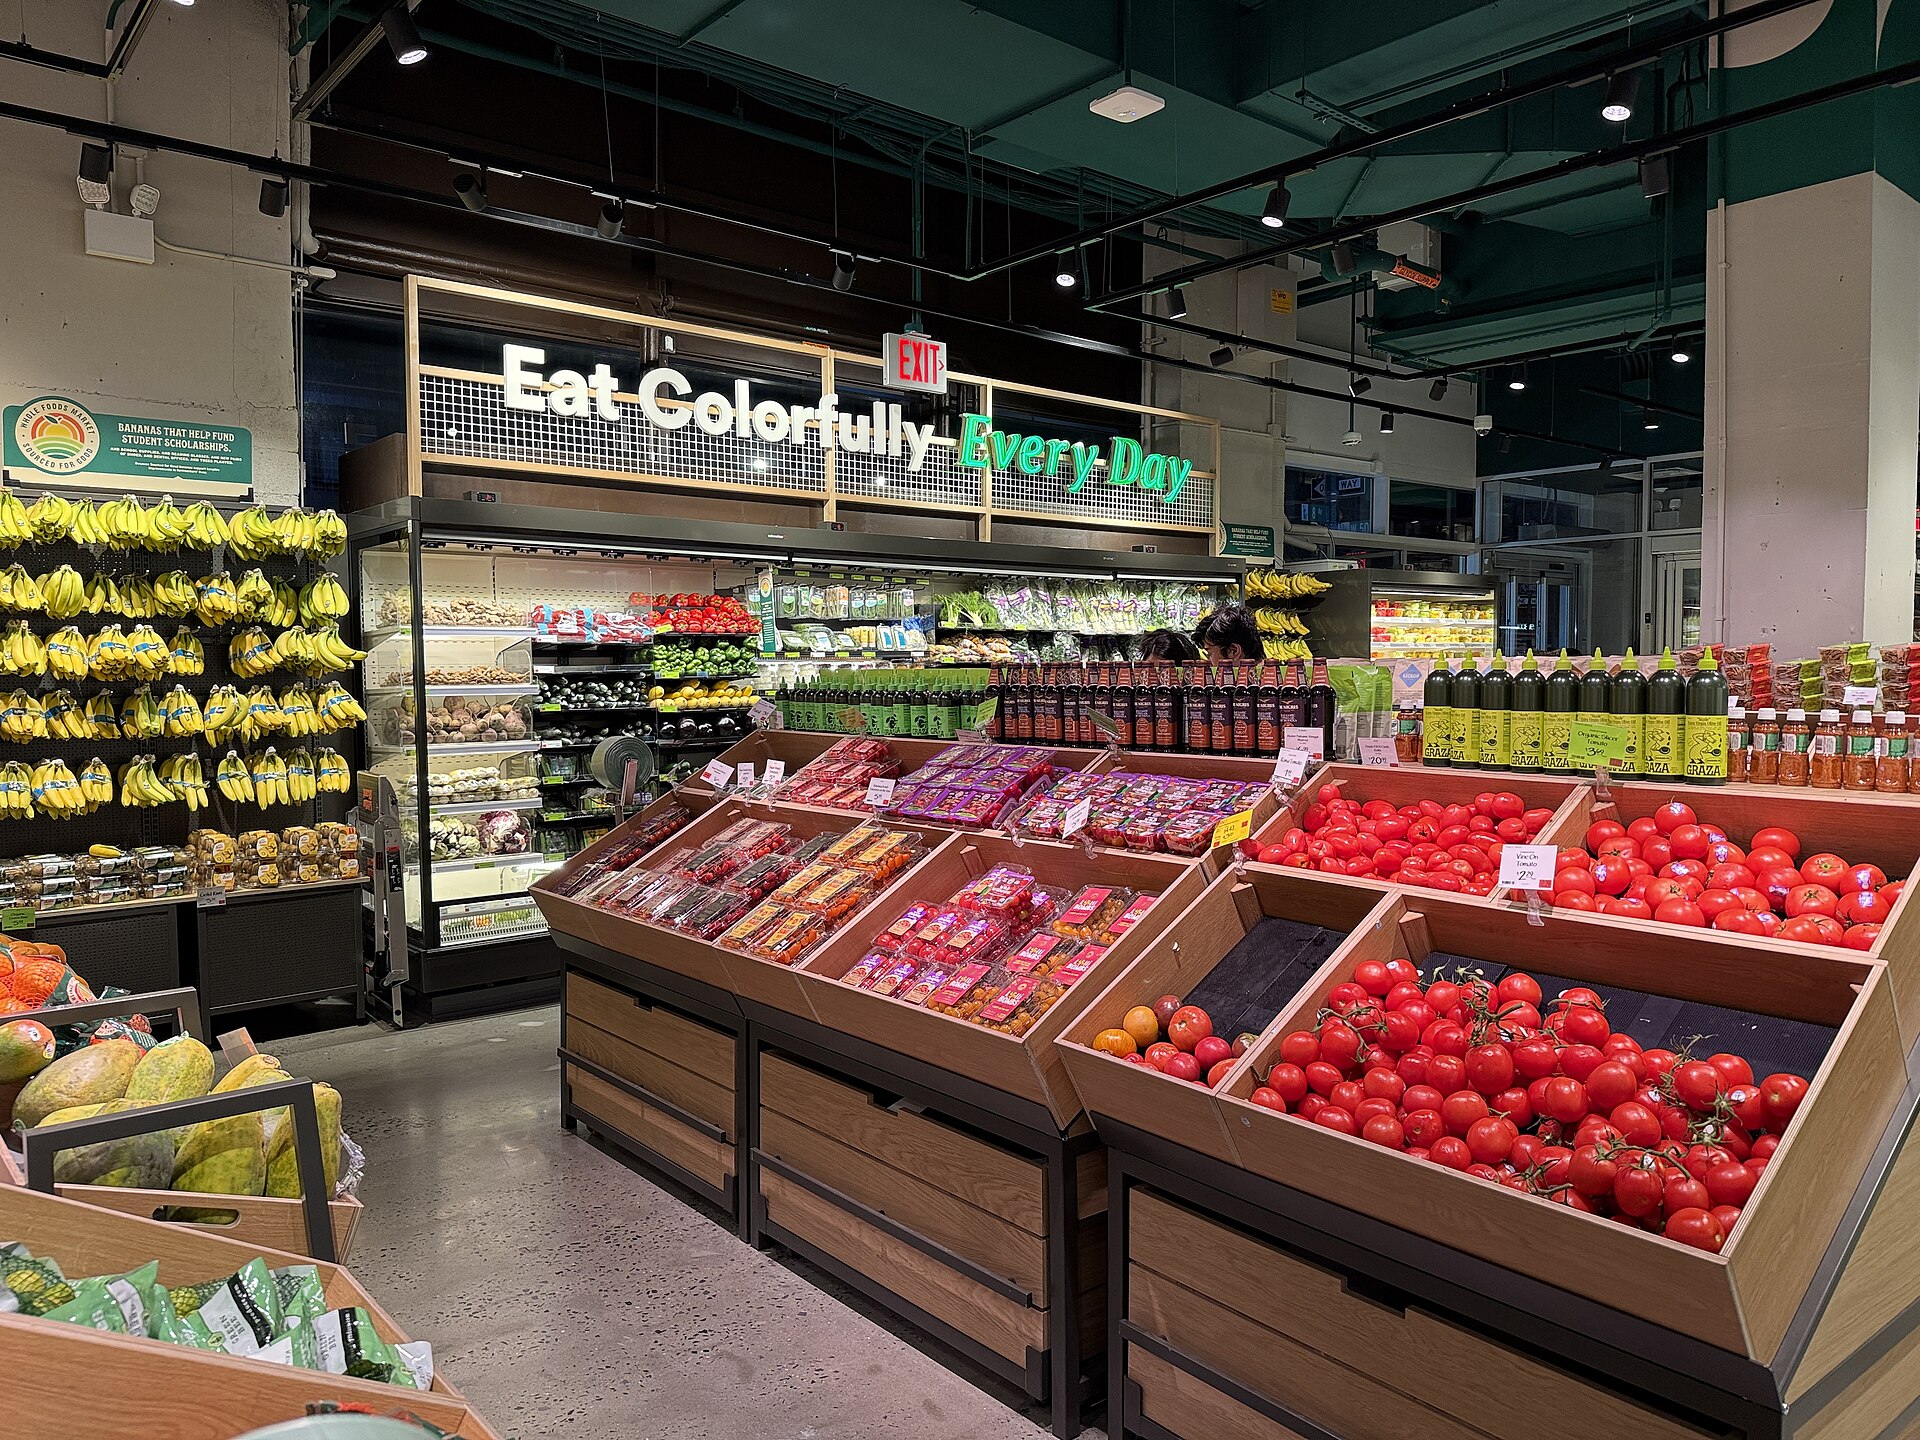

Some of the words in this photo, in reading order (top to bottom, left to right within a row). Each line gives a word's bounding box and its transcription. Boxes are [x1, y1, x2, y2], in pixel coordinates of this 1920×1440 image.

[898, 338, 940, 385] EXIT
[20, 407, 40, 429] WHOLE
[40, 403, 69, 412] FOODS
[70, 408, 96, 435] MARKET
[503, 343, 621, 422] Eat
[638, 367, 936, 473] Colorfully
[956, 412, 1100, 495] Every
[1106, 436, 1194, 504] Day
[118, 422, 162, 436] BANANAS
[163, 427, 187, 438] THAT
[188, 429, 211, 441] HELP
[212, 431, 235, 442] FUND
[121, 434, 163, 447] STUDENT
[164, 438, 232, 453] SCHOLARSHIPS.
[22, 442, 56, 469] SOURCED
[59, 461, 76, 469] FOR
[76, 447, 93, 465] GOOD
[1340, 479, 1358, 489] WAY
[1577, 730, 1600, 740] Organic
[1587, 739, 1608, 747] Tomato
[1511, 755, 1540, 765] GRAZA
[1645, 762, 1670, 773] RAZA
[1686, 764, 1722, 776] GRAZA
[219, 1314, 240, 1345] GREEN
[230, 1315, 246, 1335] BEE
